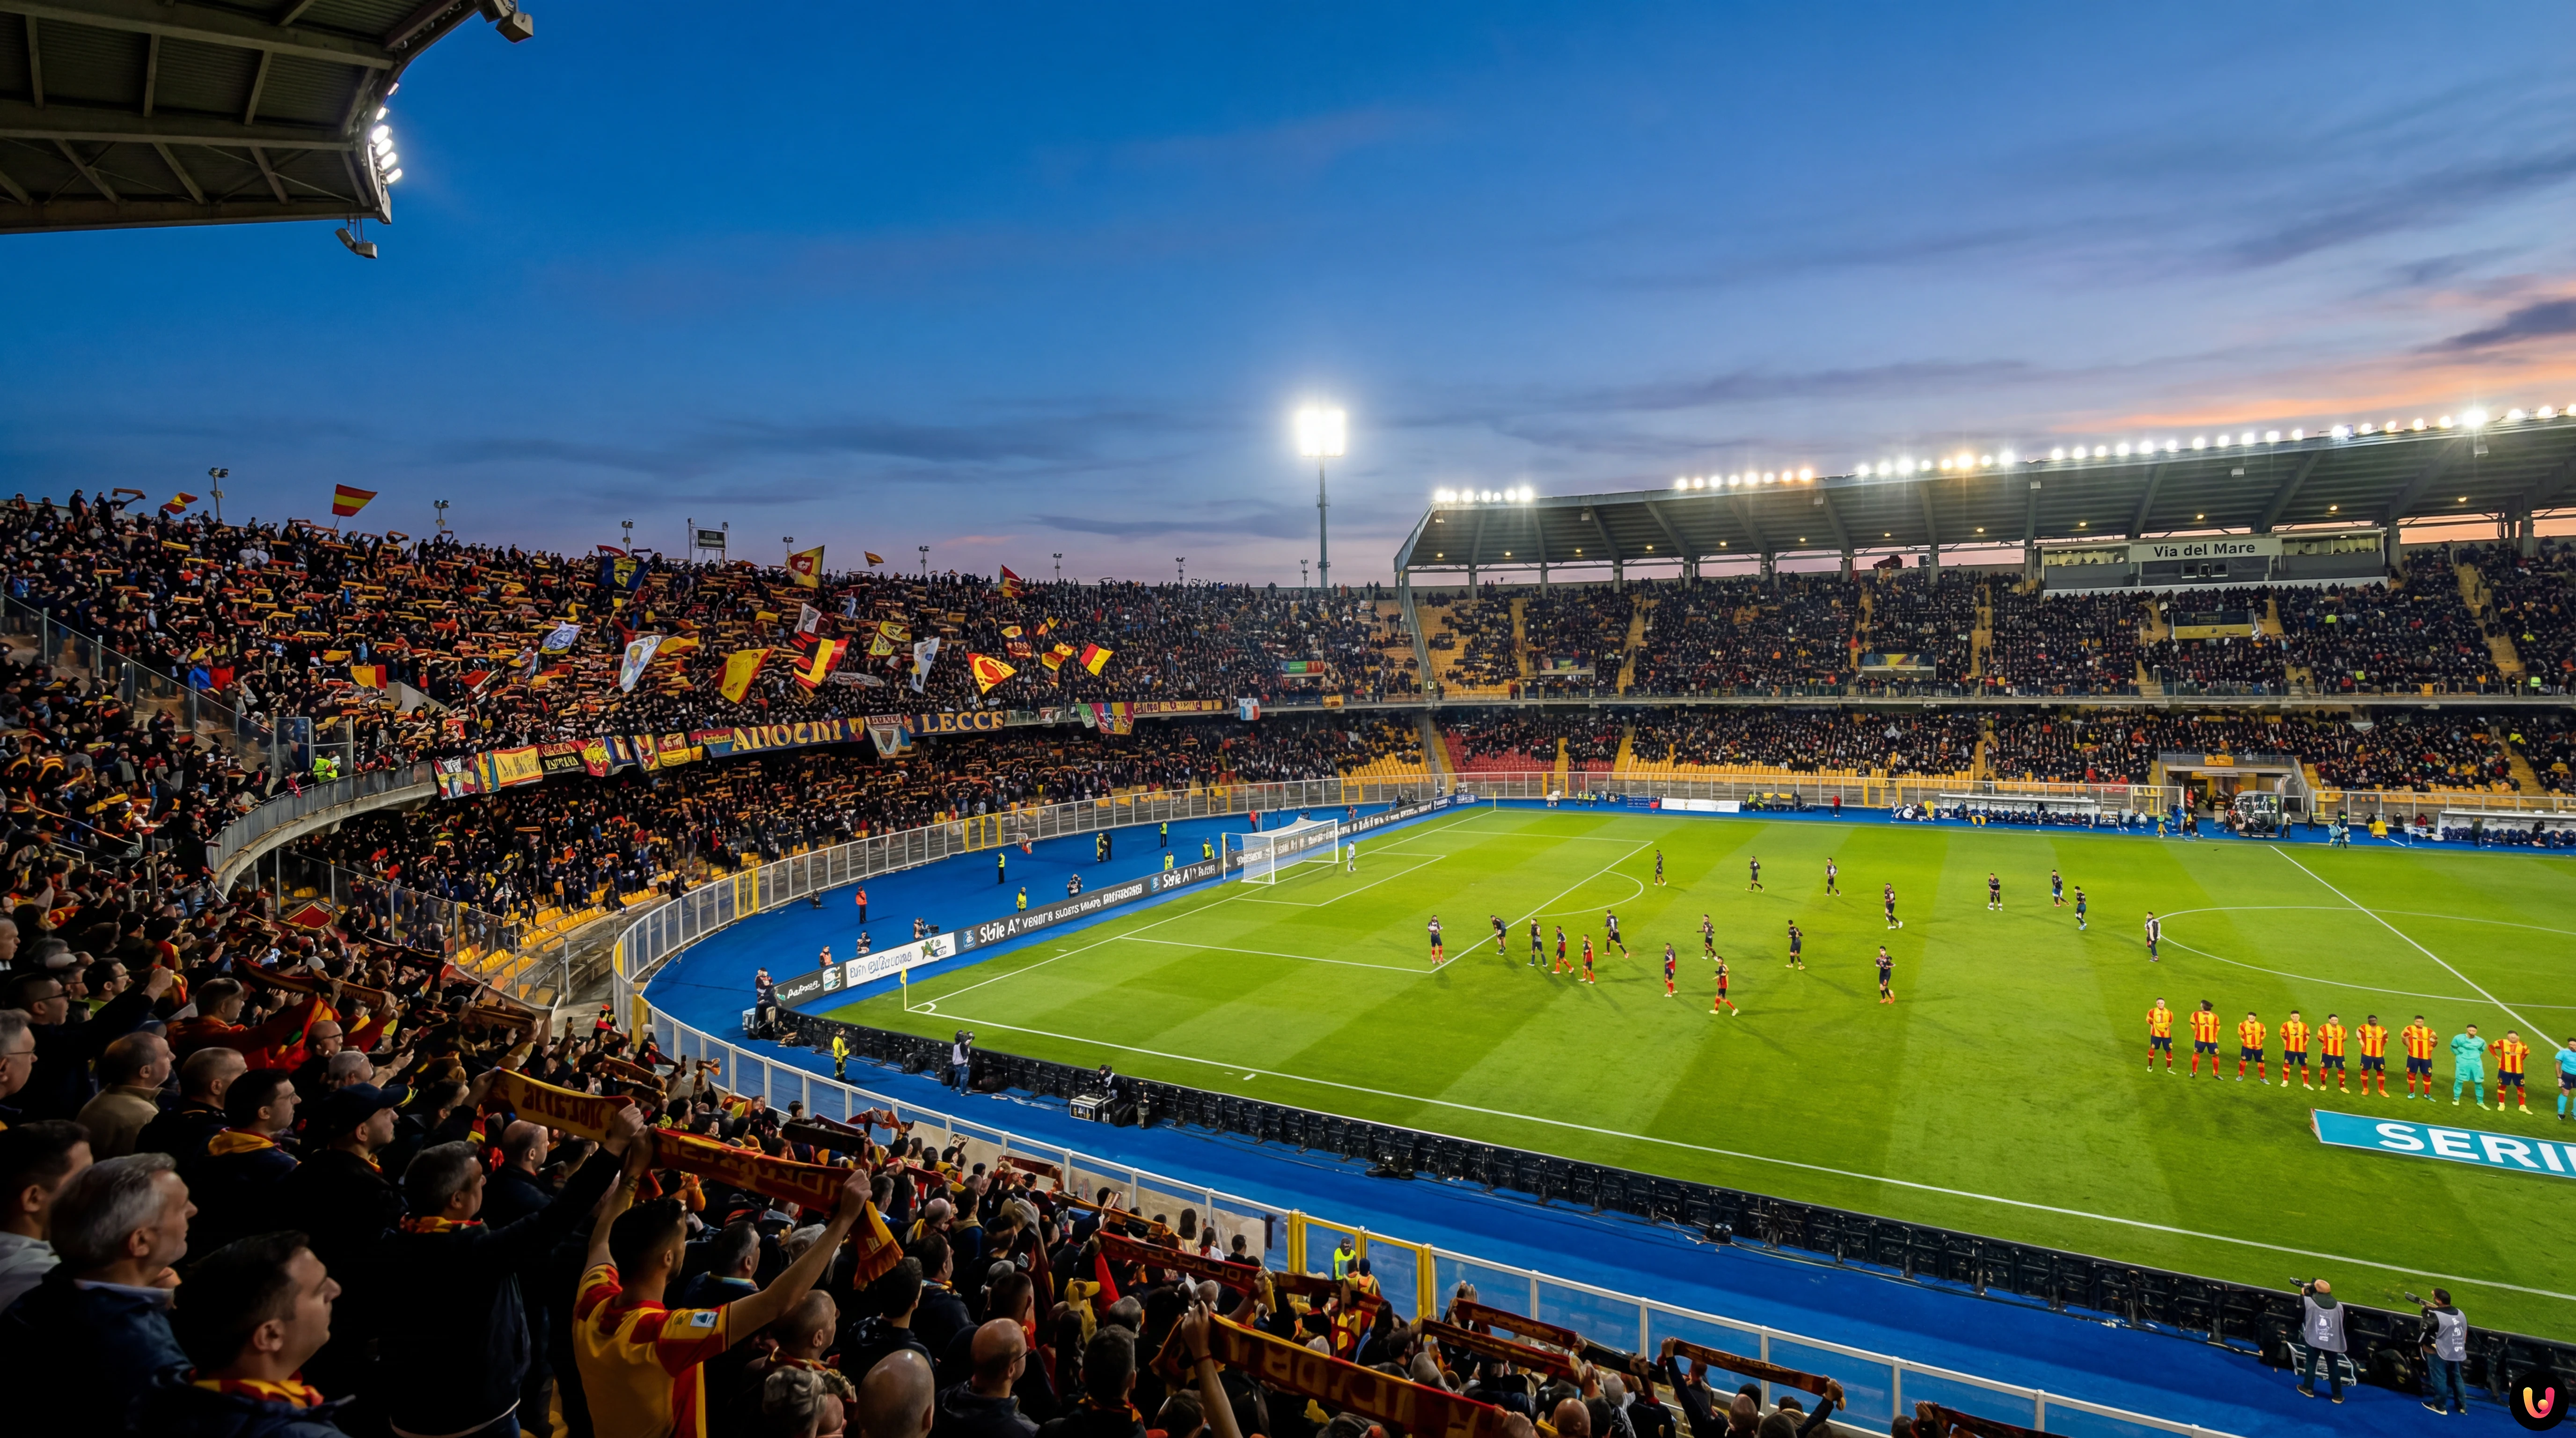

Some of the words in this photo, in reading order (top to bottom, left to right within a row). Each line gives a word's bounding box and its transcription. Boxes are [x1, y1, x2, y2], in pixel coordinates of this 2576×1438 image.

[2154, 546, 2177, 557] Via
[2184, 544, 2208, 556] del
[2214, 543, 2255, 554] Mare
[2376, 1123, 2576, 1172] SERI
